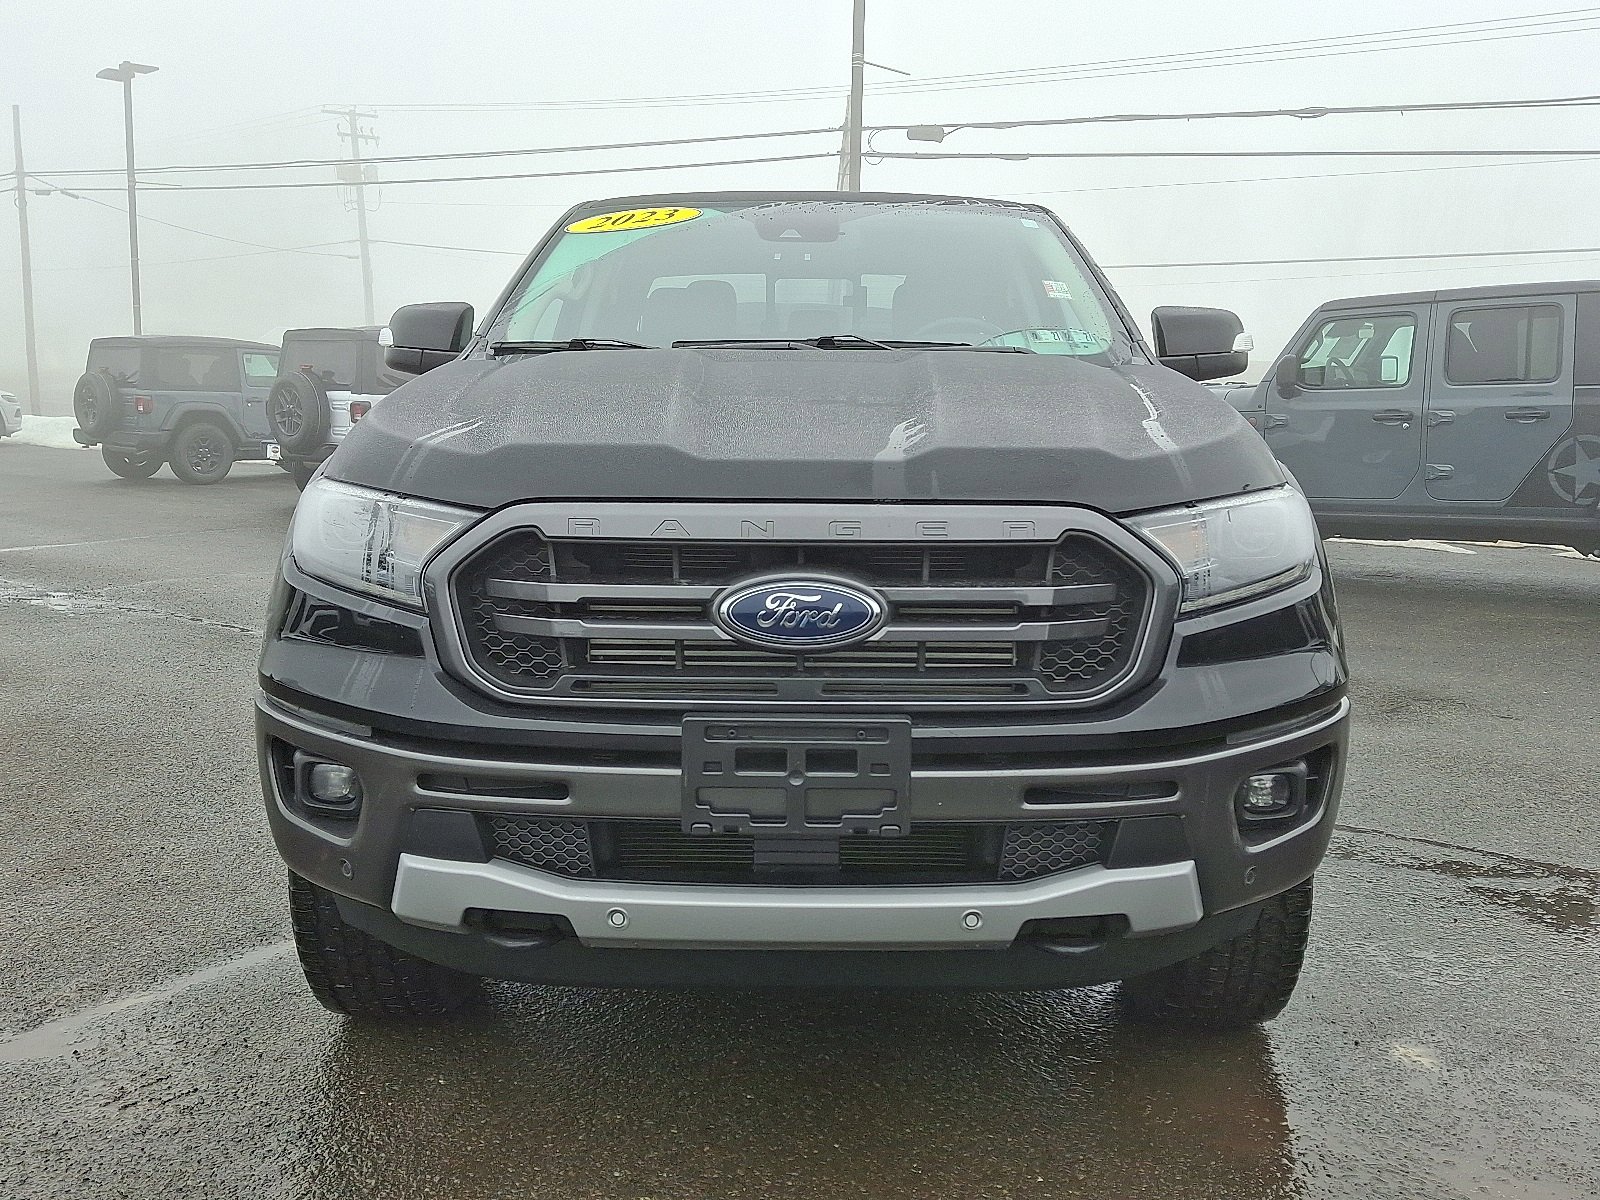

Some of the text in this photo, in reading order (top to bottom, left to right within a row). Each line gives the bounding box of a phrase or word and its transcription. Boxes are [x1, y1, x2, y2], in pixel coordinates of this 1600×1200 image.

[586, 208, 680, 230] 2023
[567, 517, 1036, 538] RANGER
[756, 592, 843, 628] Ford
